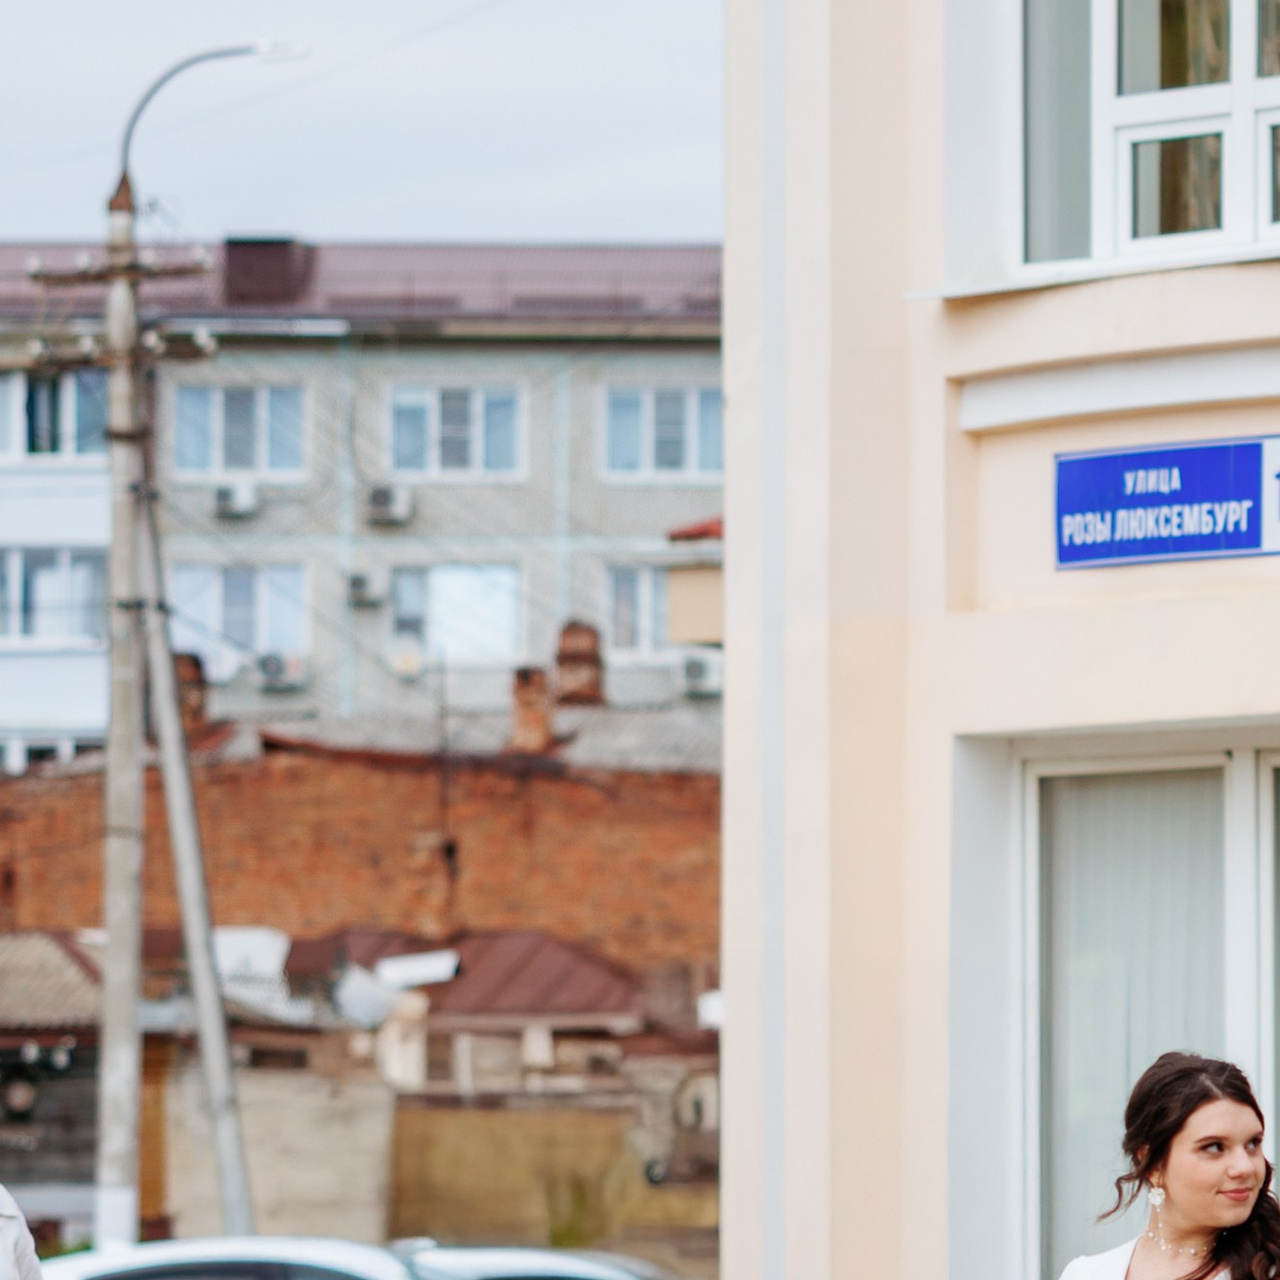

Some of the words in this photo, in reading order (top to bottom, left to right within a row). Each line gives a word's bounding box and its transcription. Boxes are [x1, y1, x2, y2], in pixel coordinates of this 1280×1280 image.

[1123, 466, 1182, 495] УЛИЦА
[1062, 510, 1112, 546] РОЗЫ
[1114, 499, 1254, 541] ЛЮКСЕМБУРГ
